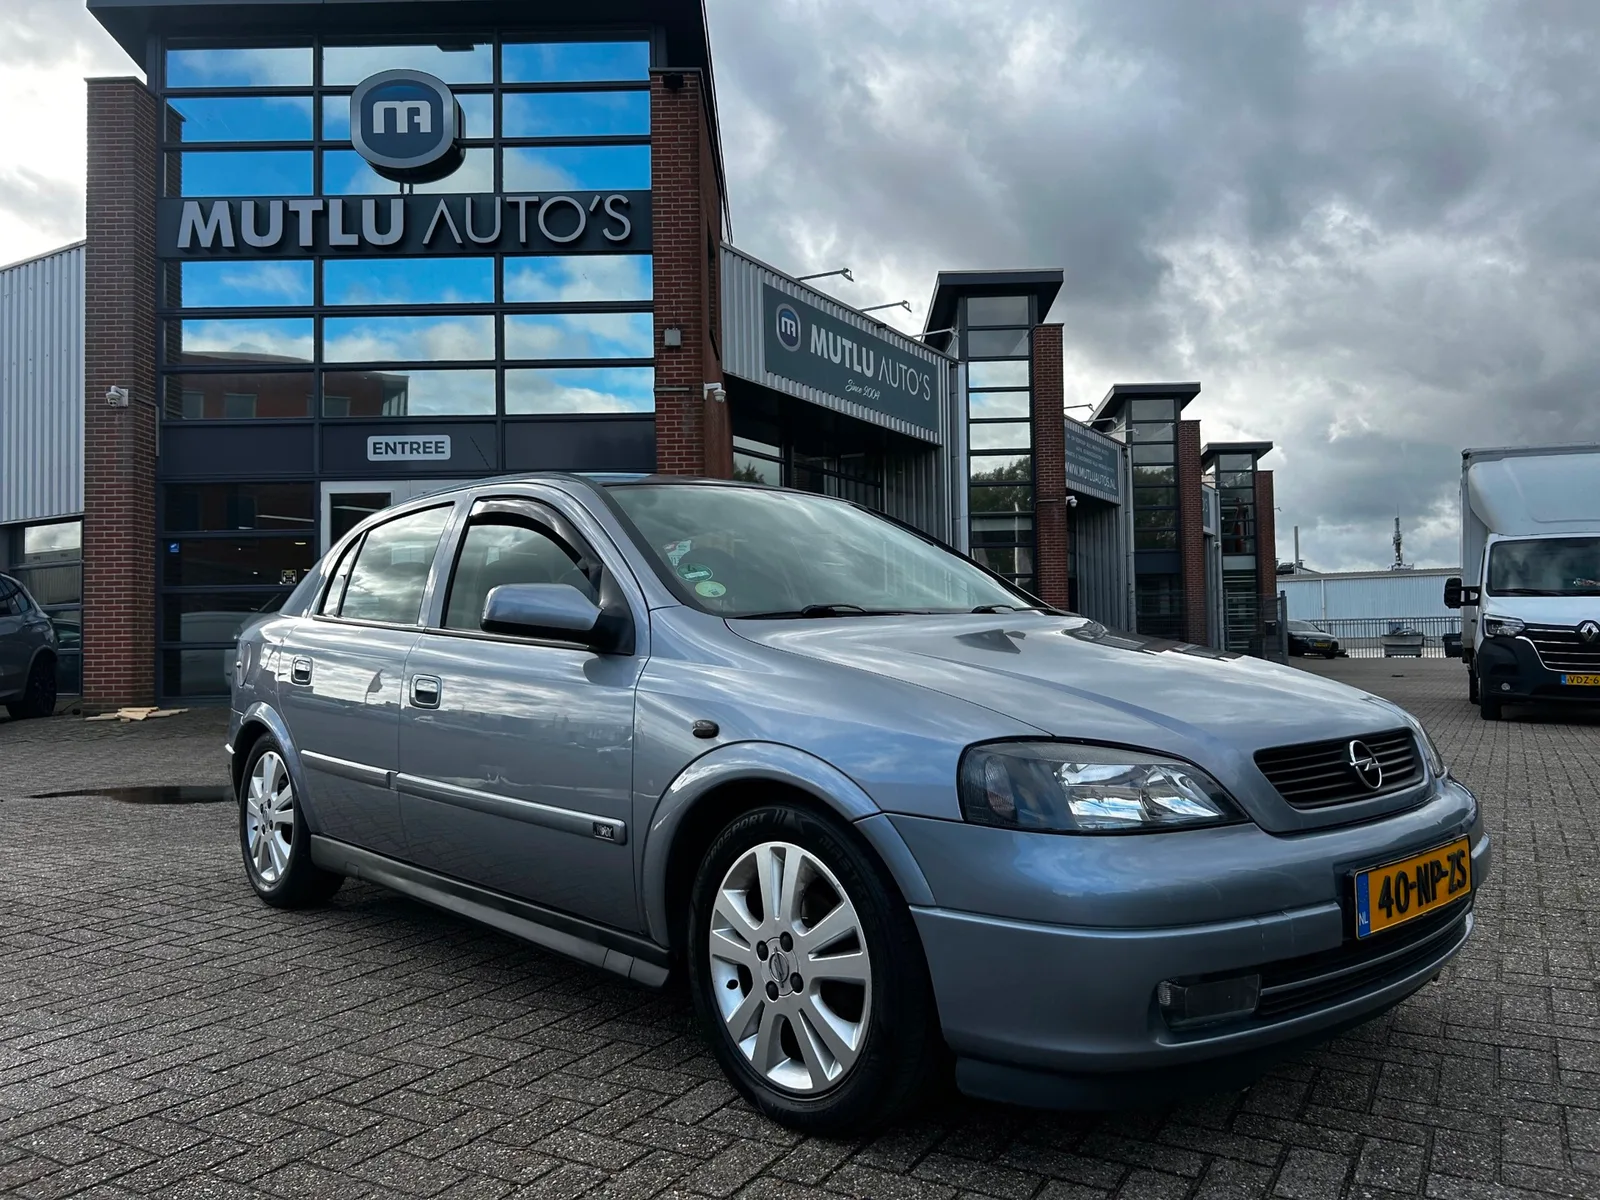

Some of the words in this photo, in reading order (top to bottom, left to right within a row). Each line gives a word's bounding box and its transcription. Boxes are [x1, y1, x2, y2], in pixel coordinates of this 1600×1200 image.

[176, 198, 405, 248] MUTLU
[422, 194, 632, 245] AUTO'S
[810, 323, 875, 378] MUTLU
[878, 355, 931, 402] AUTO'S
[845, 379, 862, 394] Since
[862, 385, 881, 400] 2004
[372, 440, 446, 455] ENTREE
[1377, 848, 1468, 919] 40-NP-ZS
[1358, 911, 1369, 926] NL
